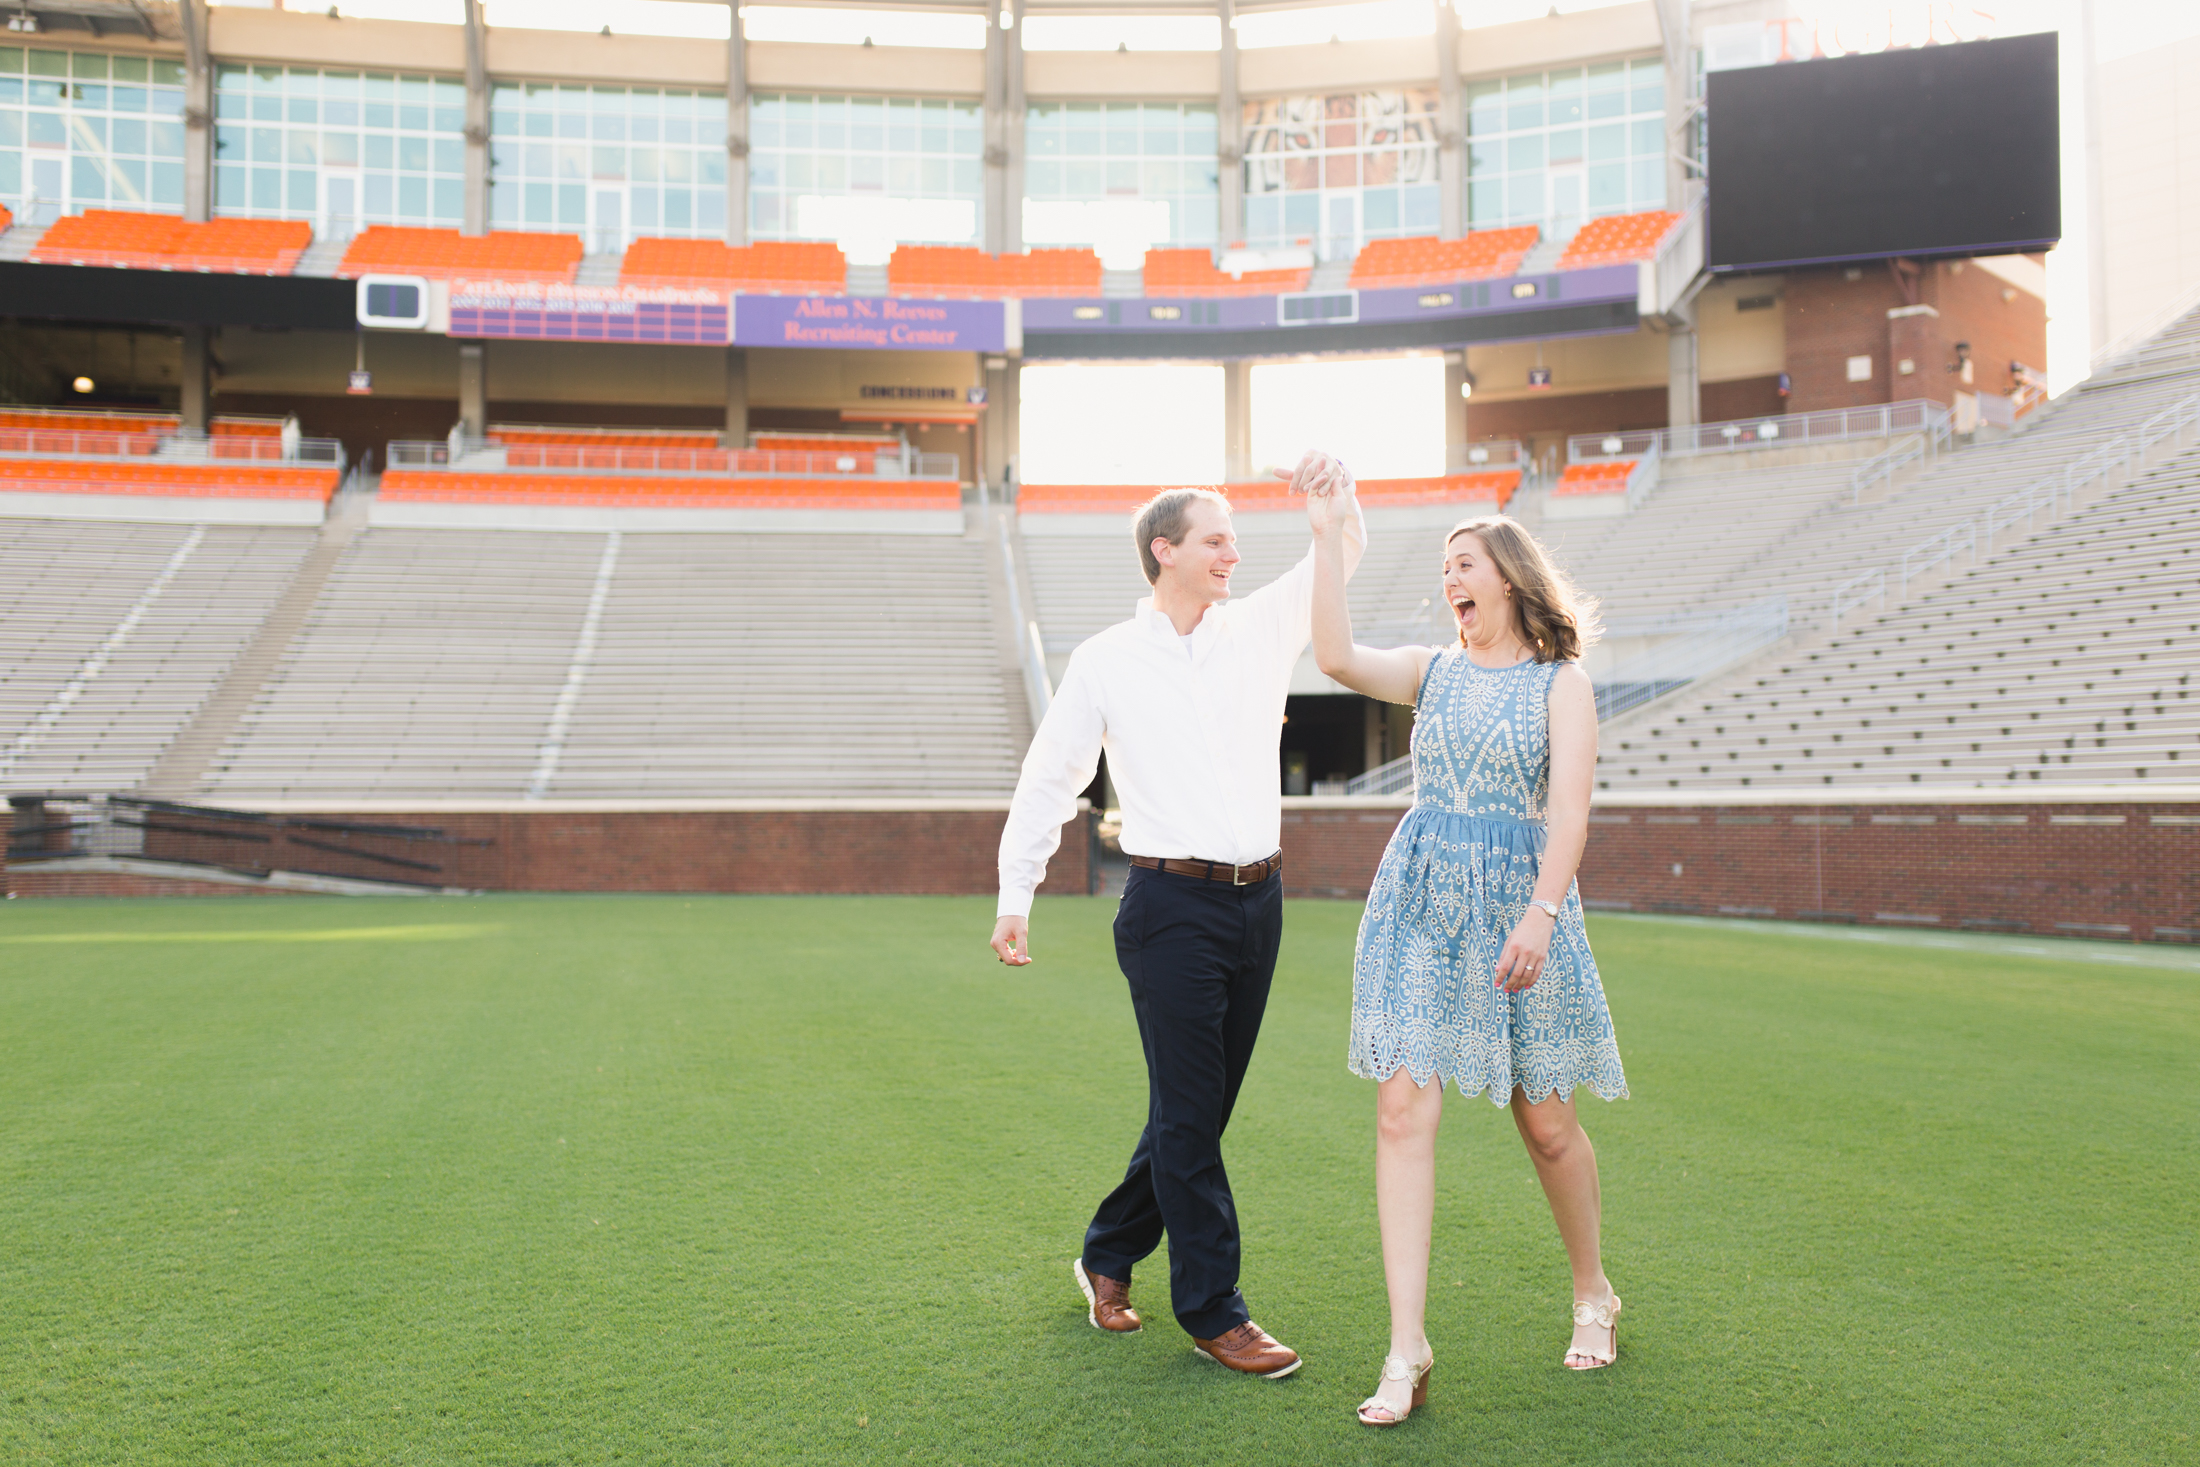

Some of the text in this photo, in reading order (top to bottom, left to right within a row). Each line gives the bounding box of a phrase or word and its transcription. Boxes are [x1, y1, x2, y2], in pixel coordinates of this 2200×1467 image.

[794, 299, 947, 320] Allen N. Reeves
[784, 320, 958, 345] Recruiting Center
